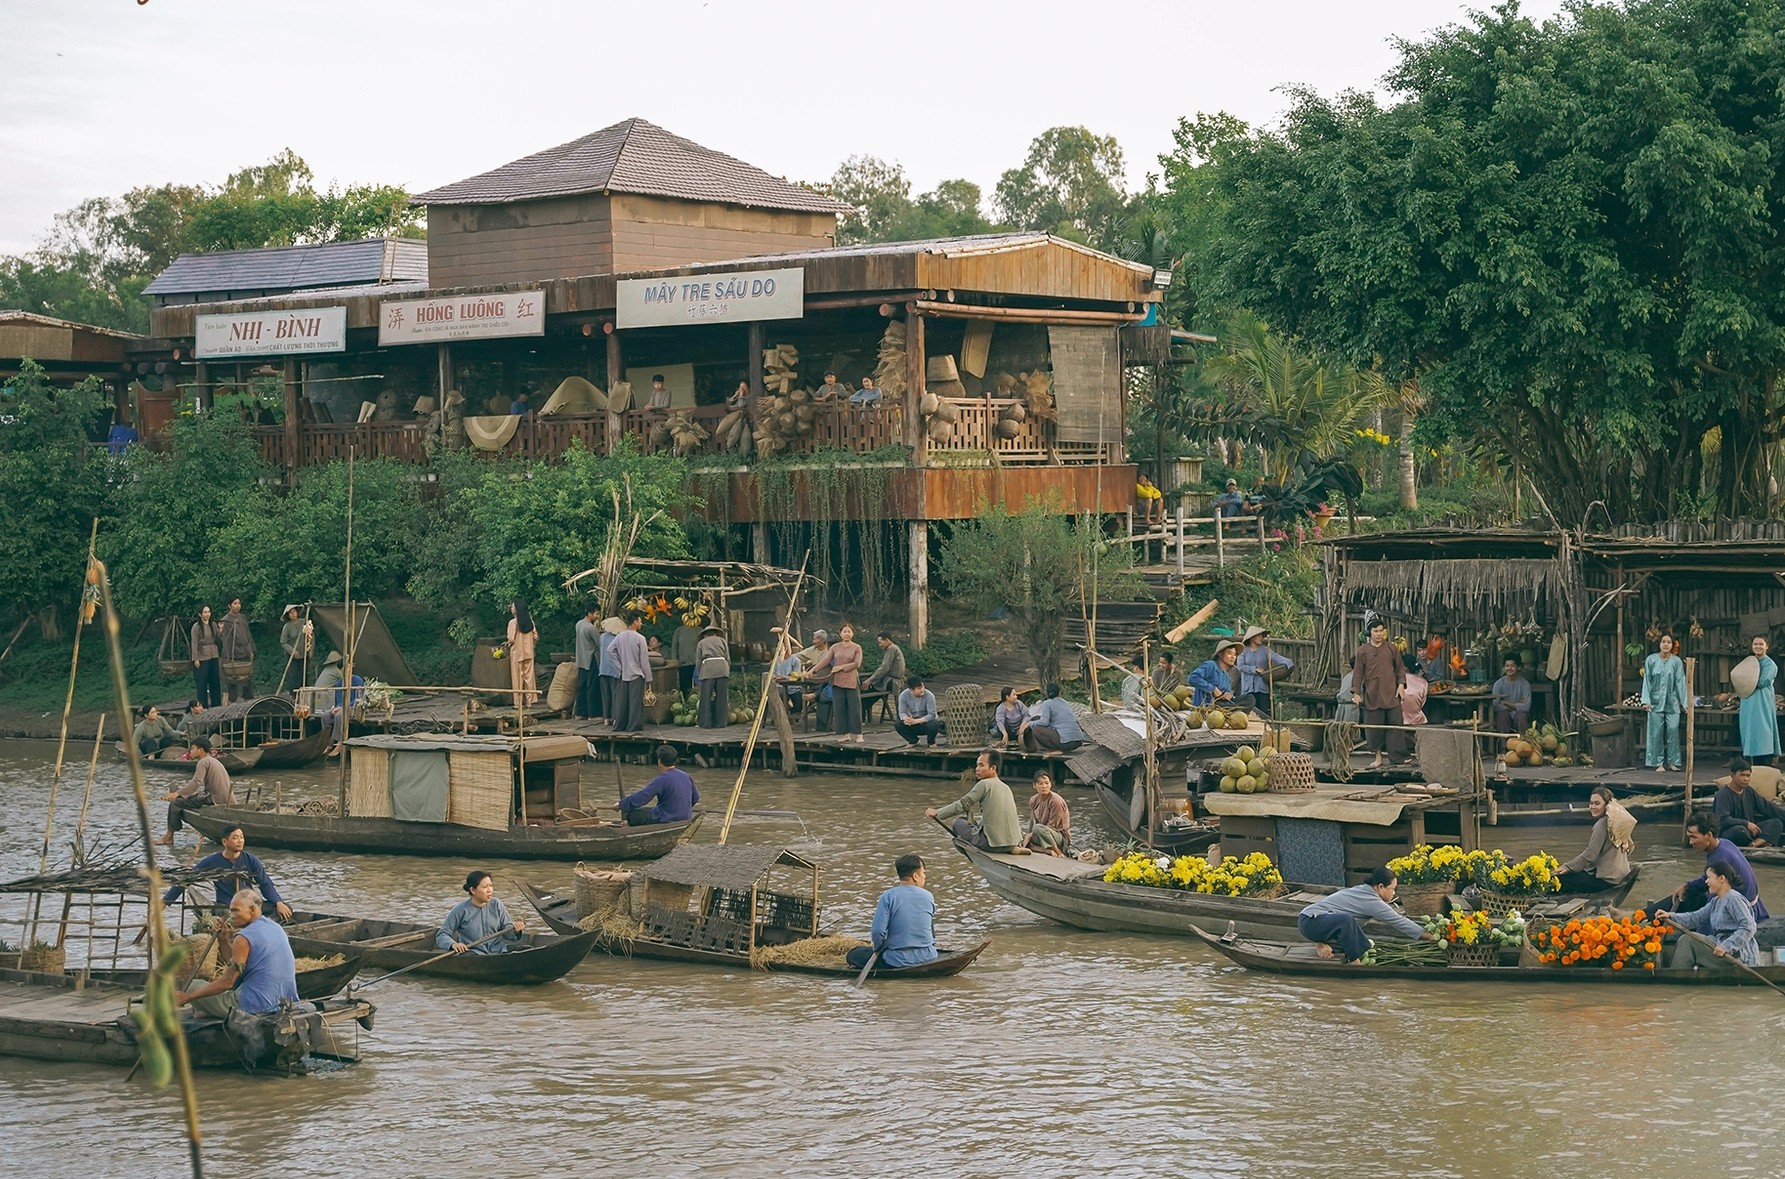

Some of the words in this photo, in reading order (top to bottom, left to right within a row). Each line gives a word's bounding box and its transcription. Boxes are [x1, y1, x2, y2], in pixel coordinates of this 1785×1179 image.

[643, 281, 677, 304] MÂY
[681, 282, 711, 302] TRE
[751, 277, 777, 299] DO
[416, 301, 454, 324] HỒNG
[460, 298, 505, 320] LUÔNG
[517, 298, 535, 319] 红
[229, 321, 263, 345] NHỊ
[275, 313, 322, 339] BÌNH
